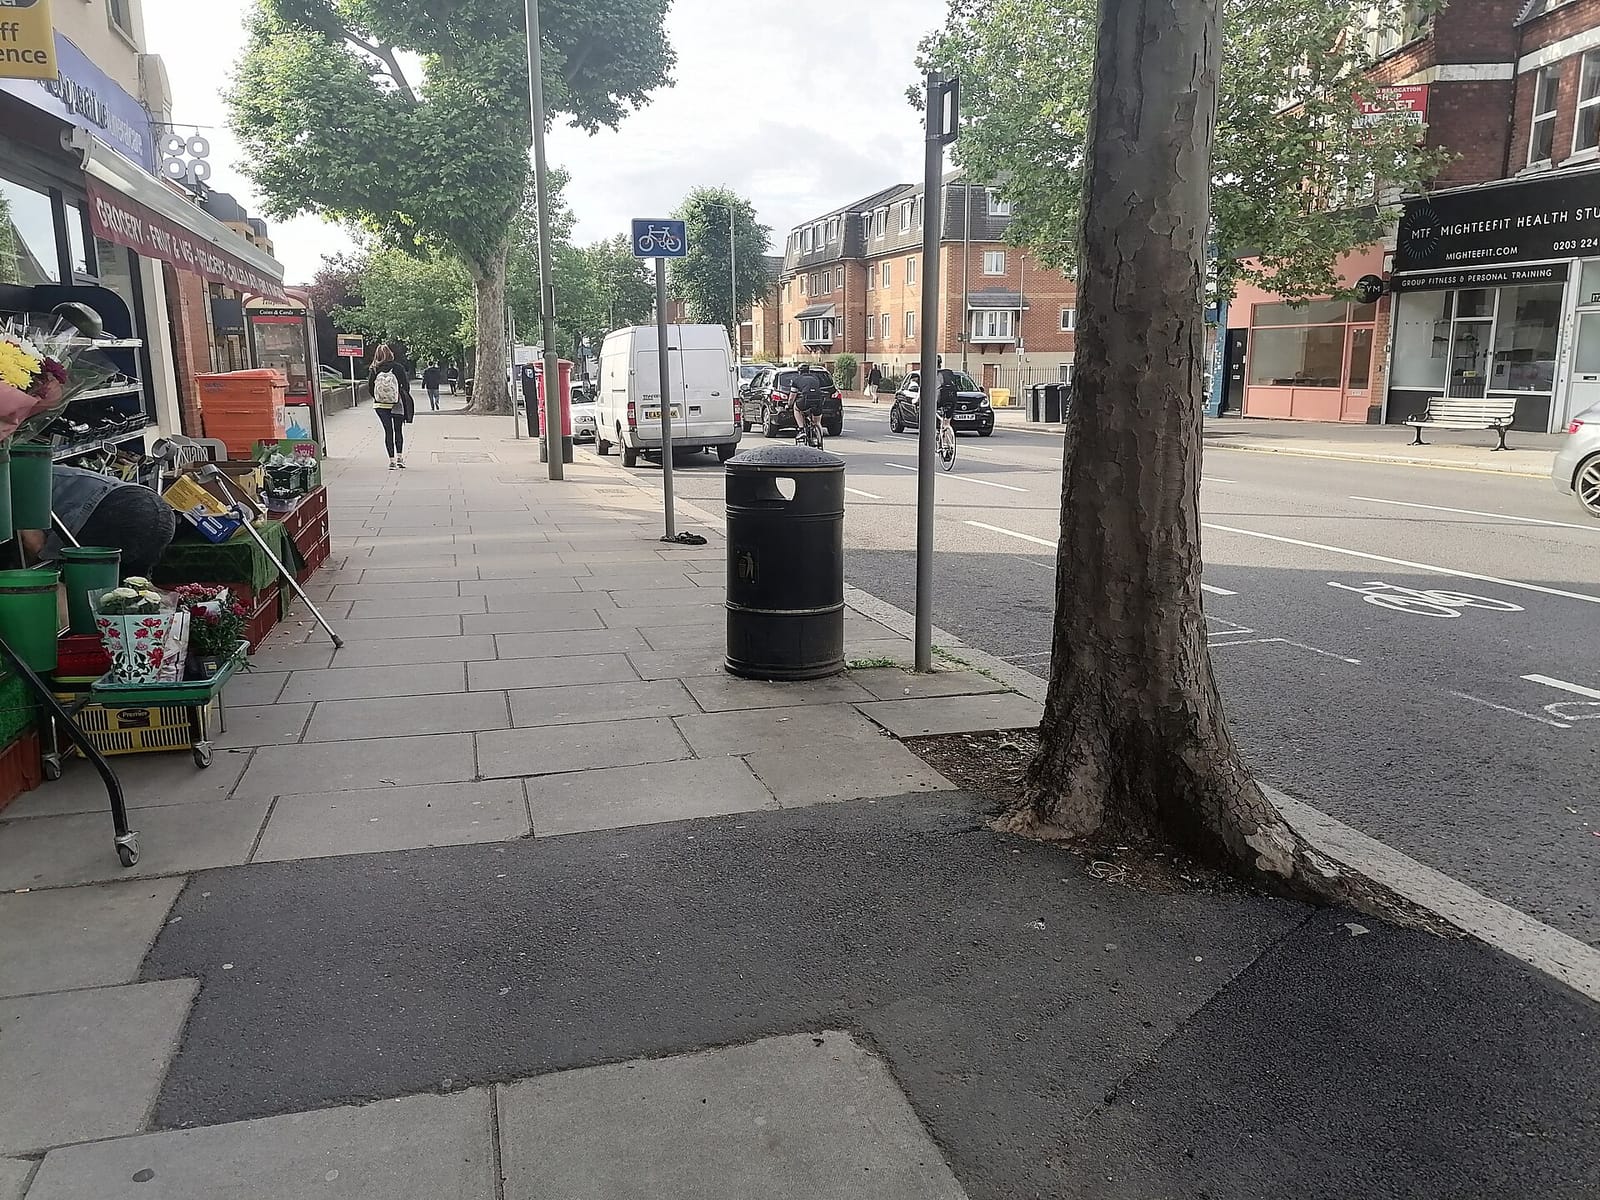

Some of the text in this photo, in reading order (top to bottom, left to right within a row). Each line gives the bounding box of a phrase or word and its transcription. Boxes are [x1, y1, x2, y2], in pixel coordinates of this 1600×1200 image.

[96, 196, 144, 245] GROCERY
[149, 224, 172, 256] FRUIT
[172, 235, 180, 260] &
[179, 238, 194, 265] VEG
[1411, 227, 1432, 240] MTF
[1440, 217, 1512, 237] MIGHTEEFIT
[1517, 210, 1569, 228] HEALTH
[1445, 237, 1598, 261] MIGHTEEFIT.COM 0203 224
[1401, 278, 1426, 287] GROUP
[1428, 275, 1457, 285] FITNESS
[1467, 272, 1508, 283] PERSONAL
[1511, 268, 1553, 280] TRAINING
